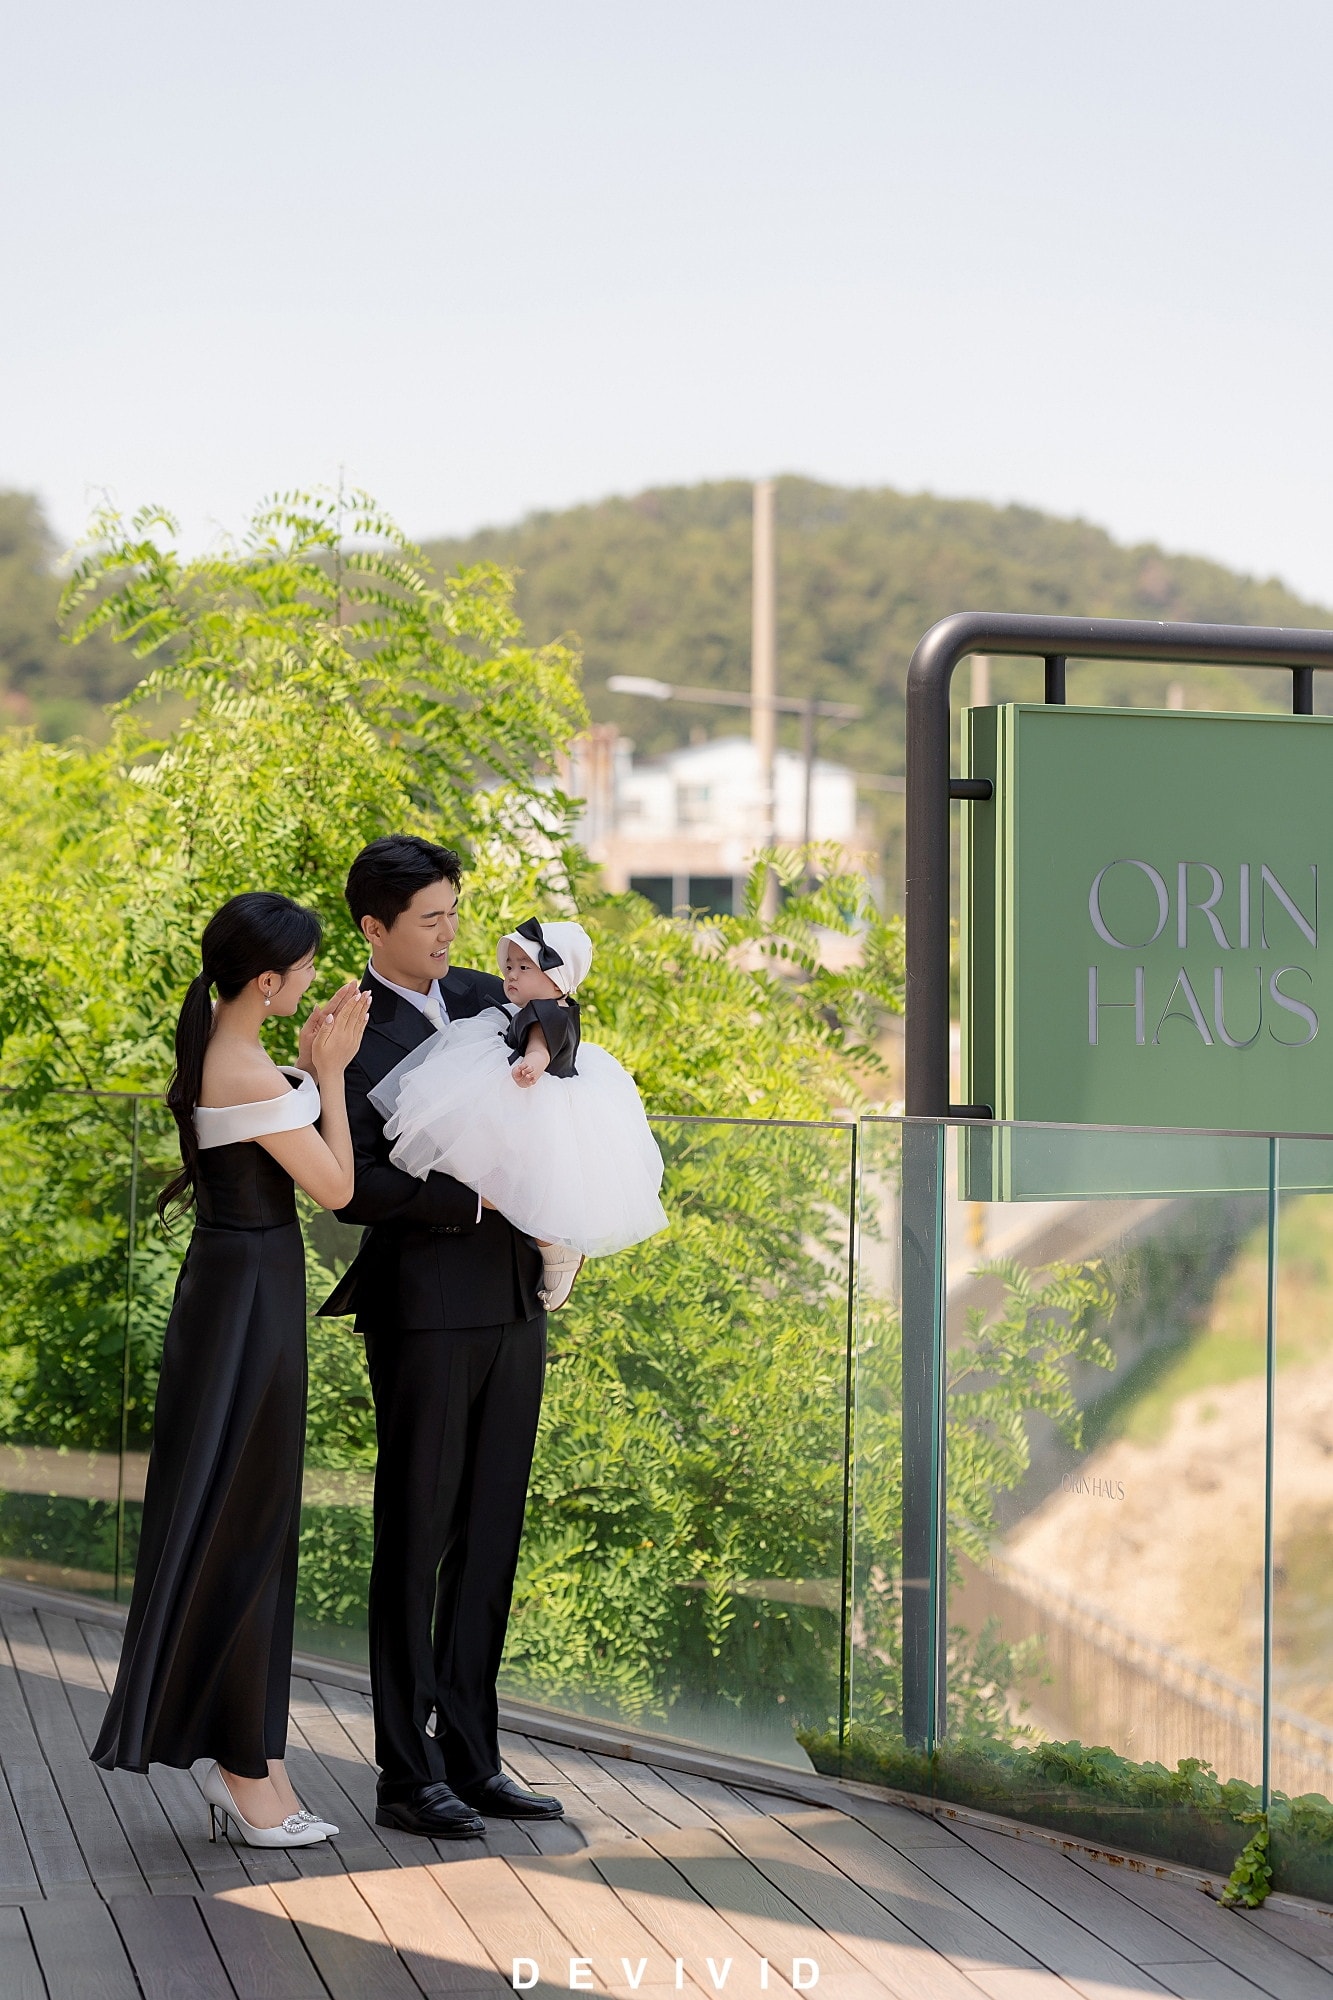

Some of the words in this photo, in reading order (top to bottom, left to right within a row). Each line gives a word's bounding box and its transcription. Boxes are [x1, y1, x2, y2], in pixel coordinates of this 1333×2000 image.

[1088, 858, 1318, 950] ORIN
[1088, 965, 1319, 1049] HAUS
[1061, 1472, 1090, 1495] ORIN
[1092, 1477, 1125, 1501] HAUS
